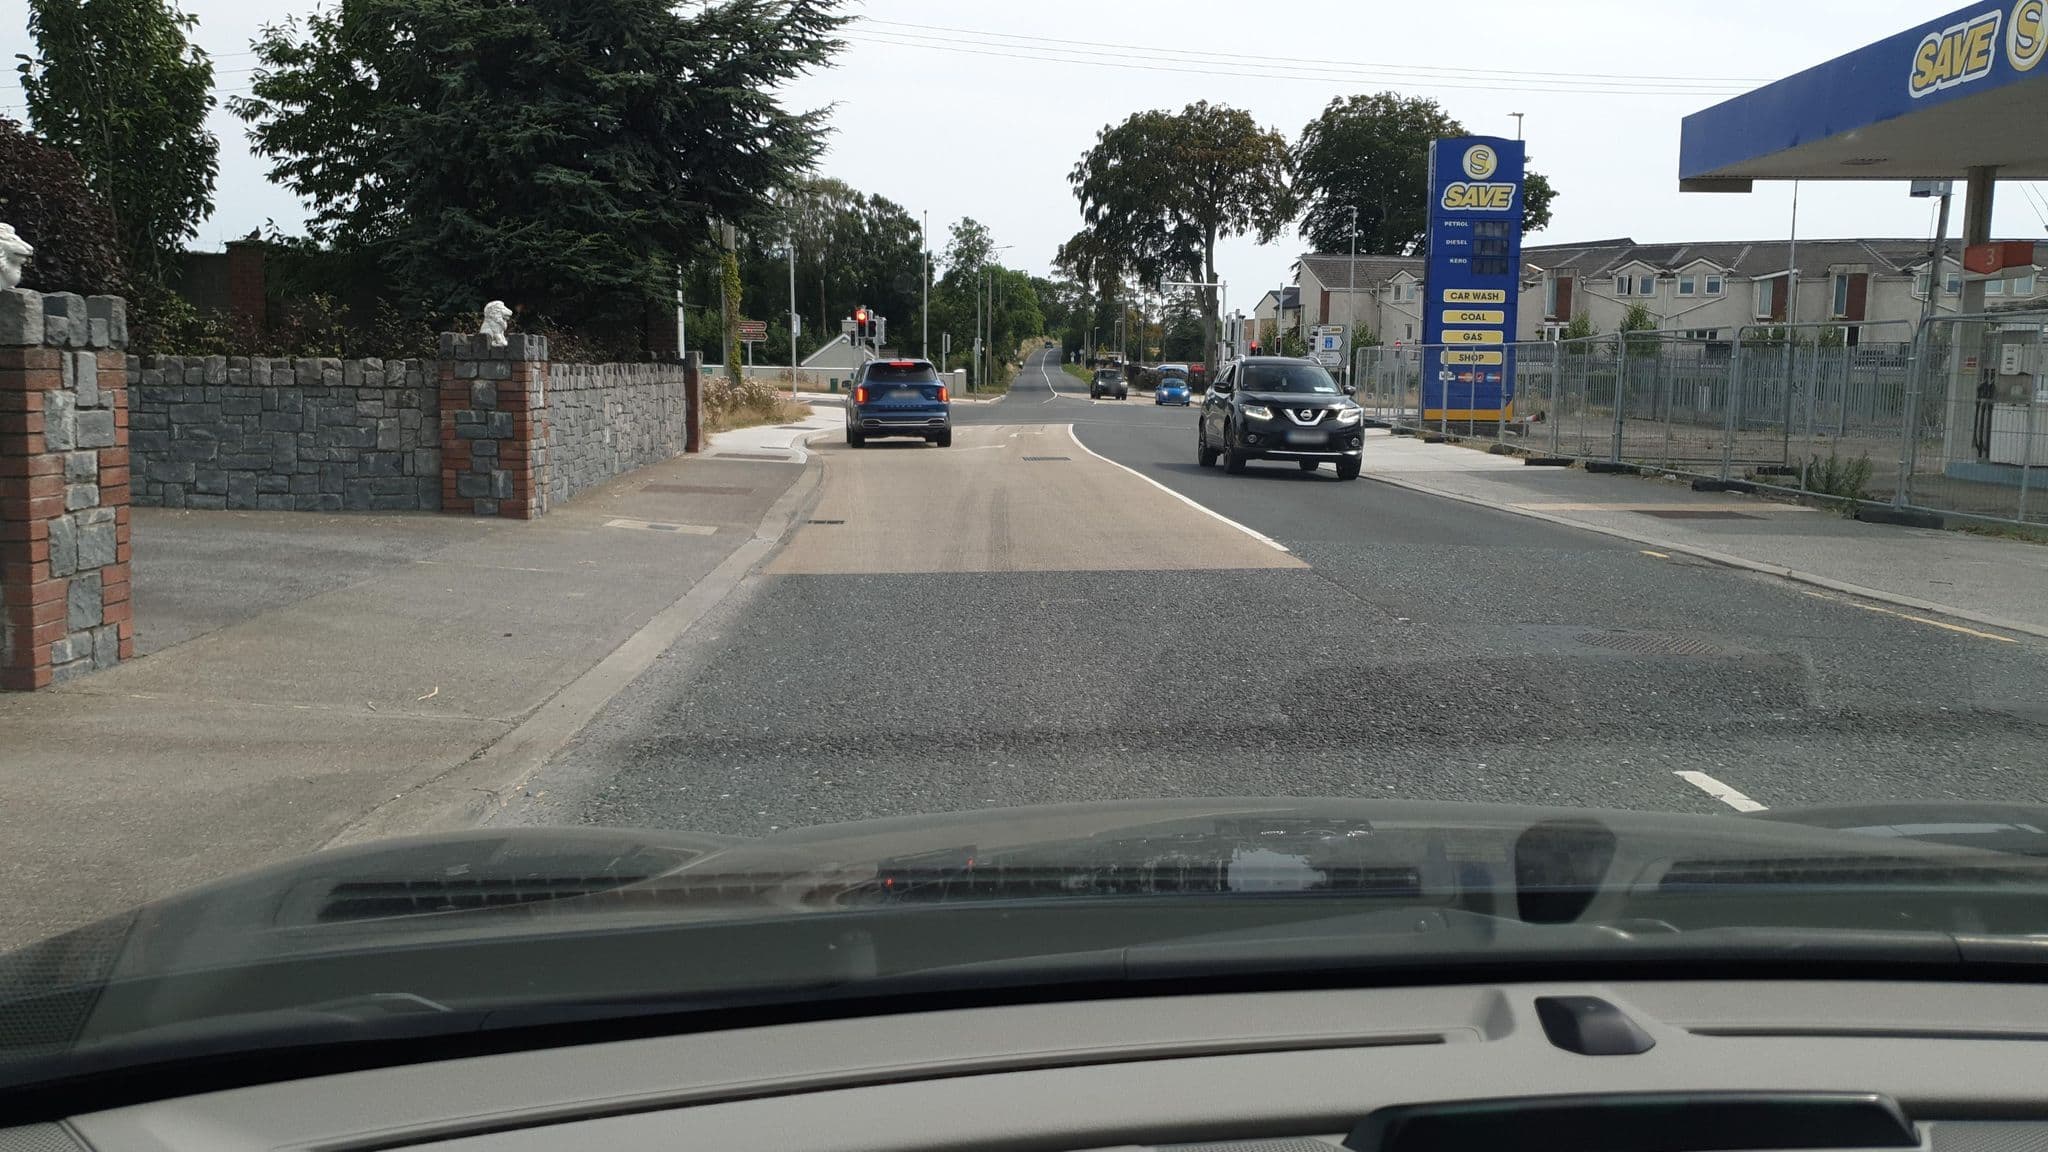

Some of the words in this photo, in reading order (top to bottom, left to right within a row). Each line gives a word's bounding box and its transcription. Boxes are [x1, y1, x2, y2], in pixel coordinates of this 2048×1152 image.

[2015, 1, 2044, 59] S
[1912, 20, 1996, 91] SAVE
[1470, 150, 1489, 175] S
[1444, 184, 1513, 207] SAVE
[1986, 249, 1995, 265] 3
[1450, 292, 1470, 300] CAR
[1472, 292, 1499, 300] WASH
[1460, 313, 1487, 321] COAL
[1462, 333, 1483, 341] GAS
[1458, 354, 1485, 362] SHOP
